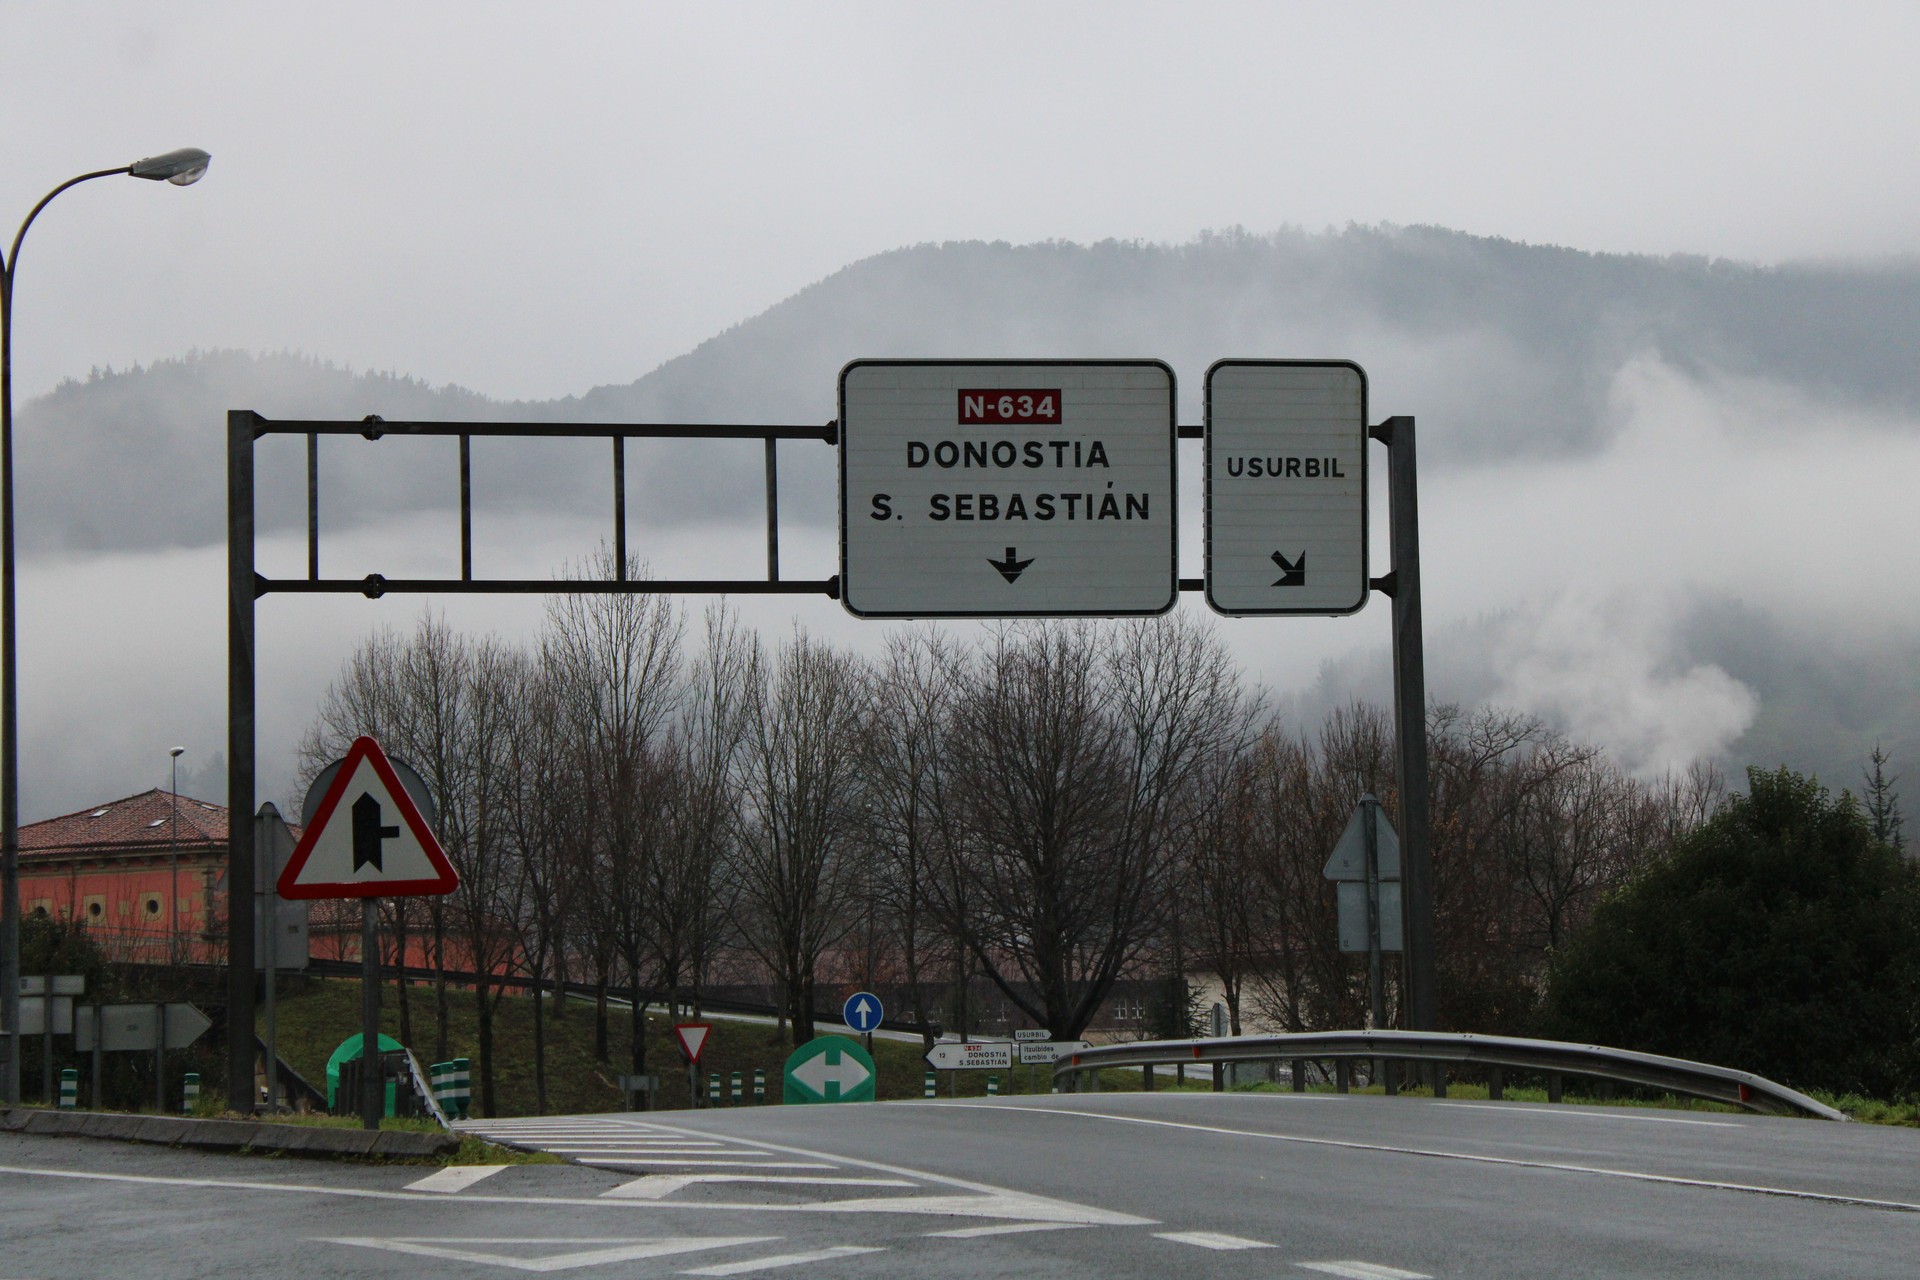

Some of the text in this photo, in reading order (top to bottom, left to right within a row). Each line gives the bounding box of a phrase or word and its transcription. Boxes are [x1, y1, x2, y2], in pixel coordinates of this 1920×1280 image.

[964, 395, 1056, 419] N-634
[907, 440, 1110, 469] DONOSTIA
[1227, 457, 1345, 478] USURBIL
[870, 481, 1150, 521] S. SEBASTIÁN
